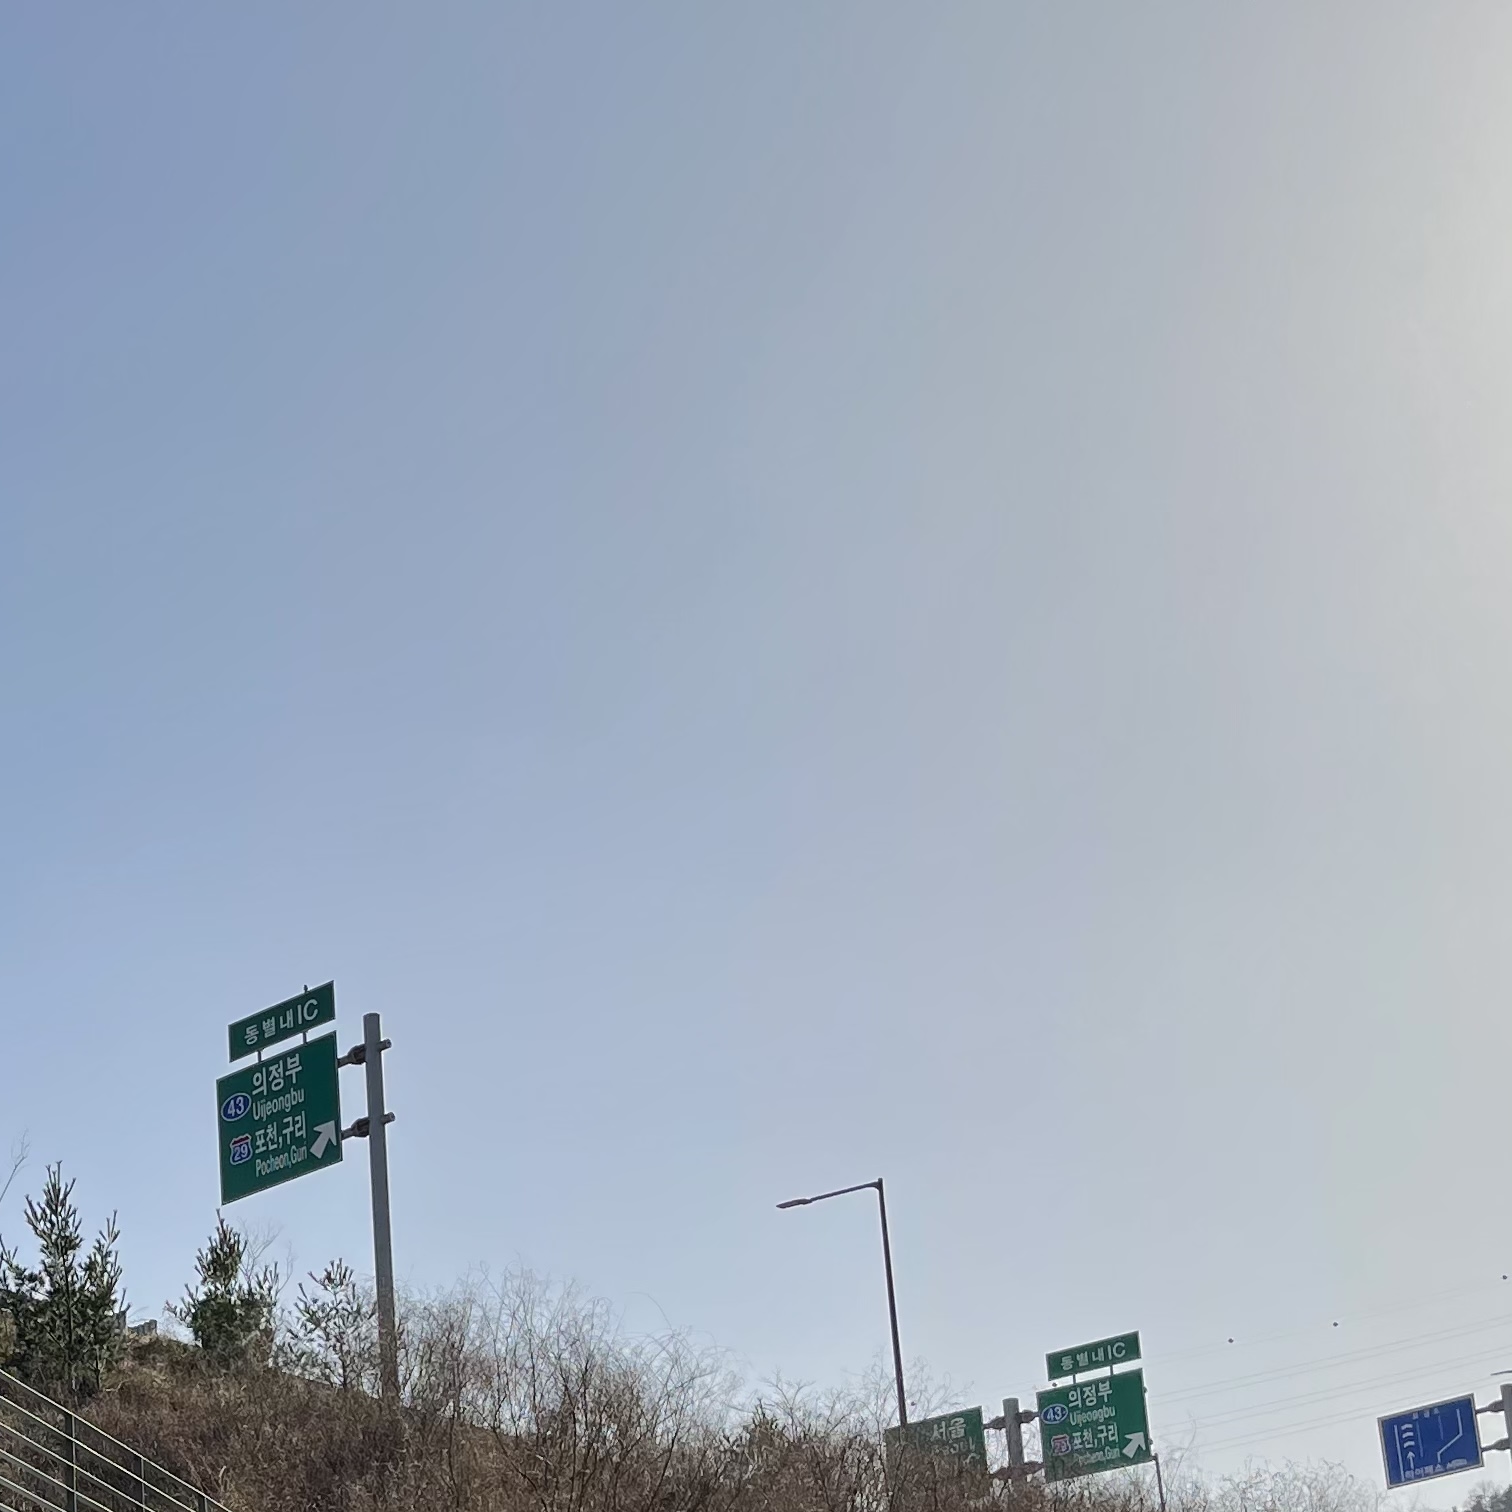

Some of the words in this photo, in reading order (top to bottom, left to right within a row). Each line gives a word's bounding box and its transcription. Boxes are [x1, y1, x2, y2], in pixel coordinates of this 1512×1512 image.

[252, 1053, 303, 1096] 의정부
[227, 1097, 245, 1117] 43
[252, 1087, 305, 1122] Uijeongbu
[233, 1146, 248, 1162] 29
[1068, 1380, 1113, 1408] 의정부
[1047, 1406, 1062, 1421] 43
[930, 1417, 966, 1441] 서울
